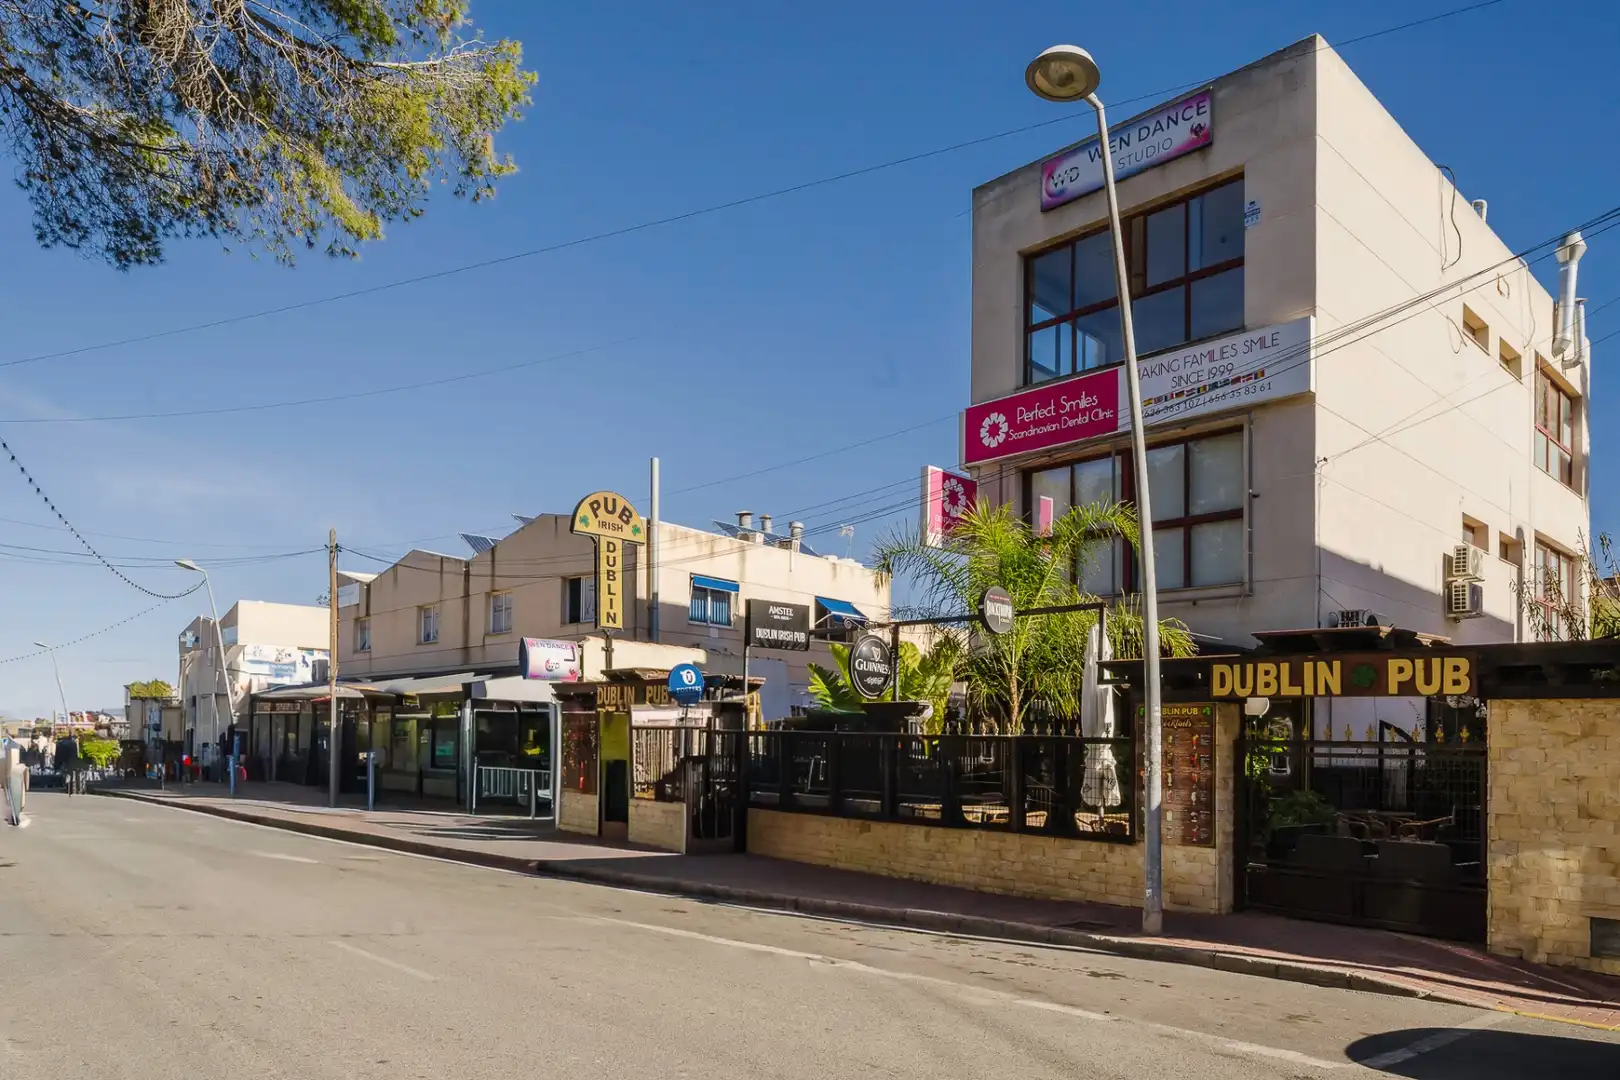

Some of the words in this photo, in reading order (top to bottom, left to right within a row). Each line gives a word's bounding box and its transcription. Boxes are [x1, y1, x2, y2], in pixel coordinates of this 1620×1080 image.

[1138, 100, 1208, 143] DANCE
[1117, 137, 1173, 171] STUDIO
[1138, 358, 1181, 381] AKING
[1242, 331, 1281, 355] SMILE
[1171, 369, 1206, 389] SINCE
[1207, 362, 1235, 380] 1999
[1244, 385, 1257, 396] 83
[1259, 381, 1273, 392] 61
[1016, 400, 1056, 425] Perfect
[1059, 390, 1099, 415] Smiles
[1008, 422, 1061, 442] Scandinavian
[1061, 412, 1090, 430] Dental
[1090, 407, 1114, 422] Clinic
[588, 496, 634, 526] PUB
[598, 519, 624, 533] IRISH
[606, 541, 617, 624] DUBLIN
[768, 605, 794, 617] AMSTEL
[793, 631, 806, 643] PUB
[1212, 659, 1342, 697] DUBLIN
[1387, 657, 1471, 696] PUB
[596, 685, 636, 706] DUBLIN
[645, 684, 669, 705] PUB
[1162, 707, 1180, 715] BLIN
[1181, 707, 1199, 715] PUB
